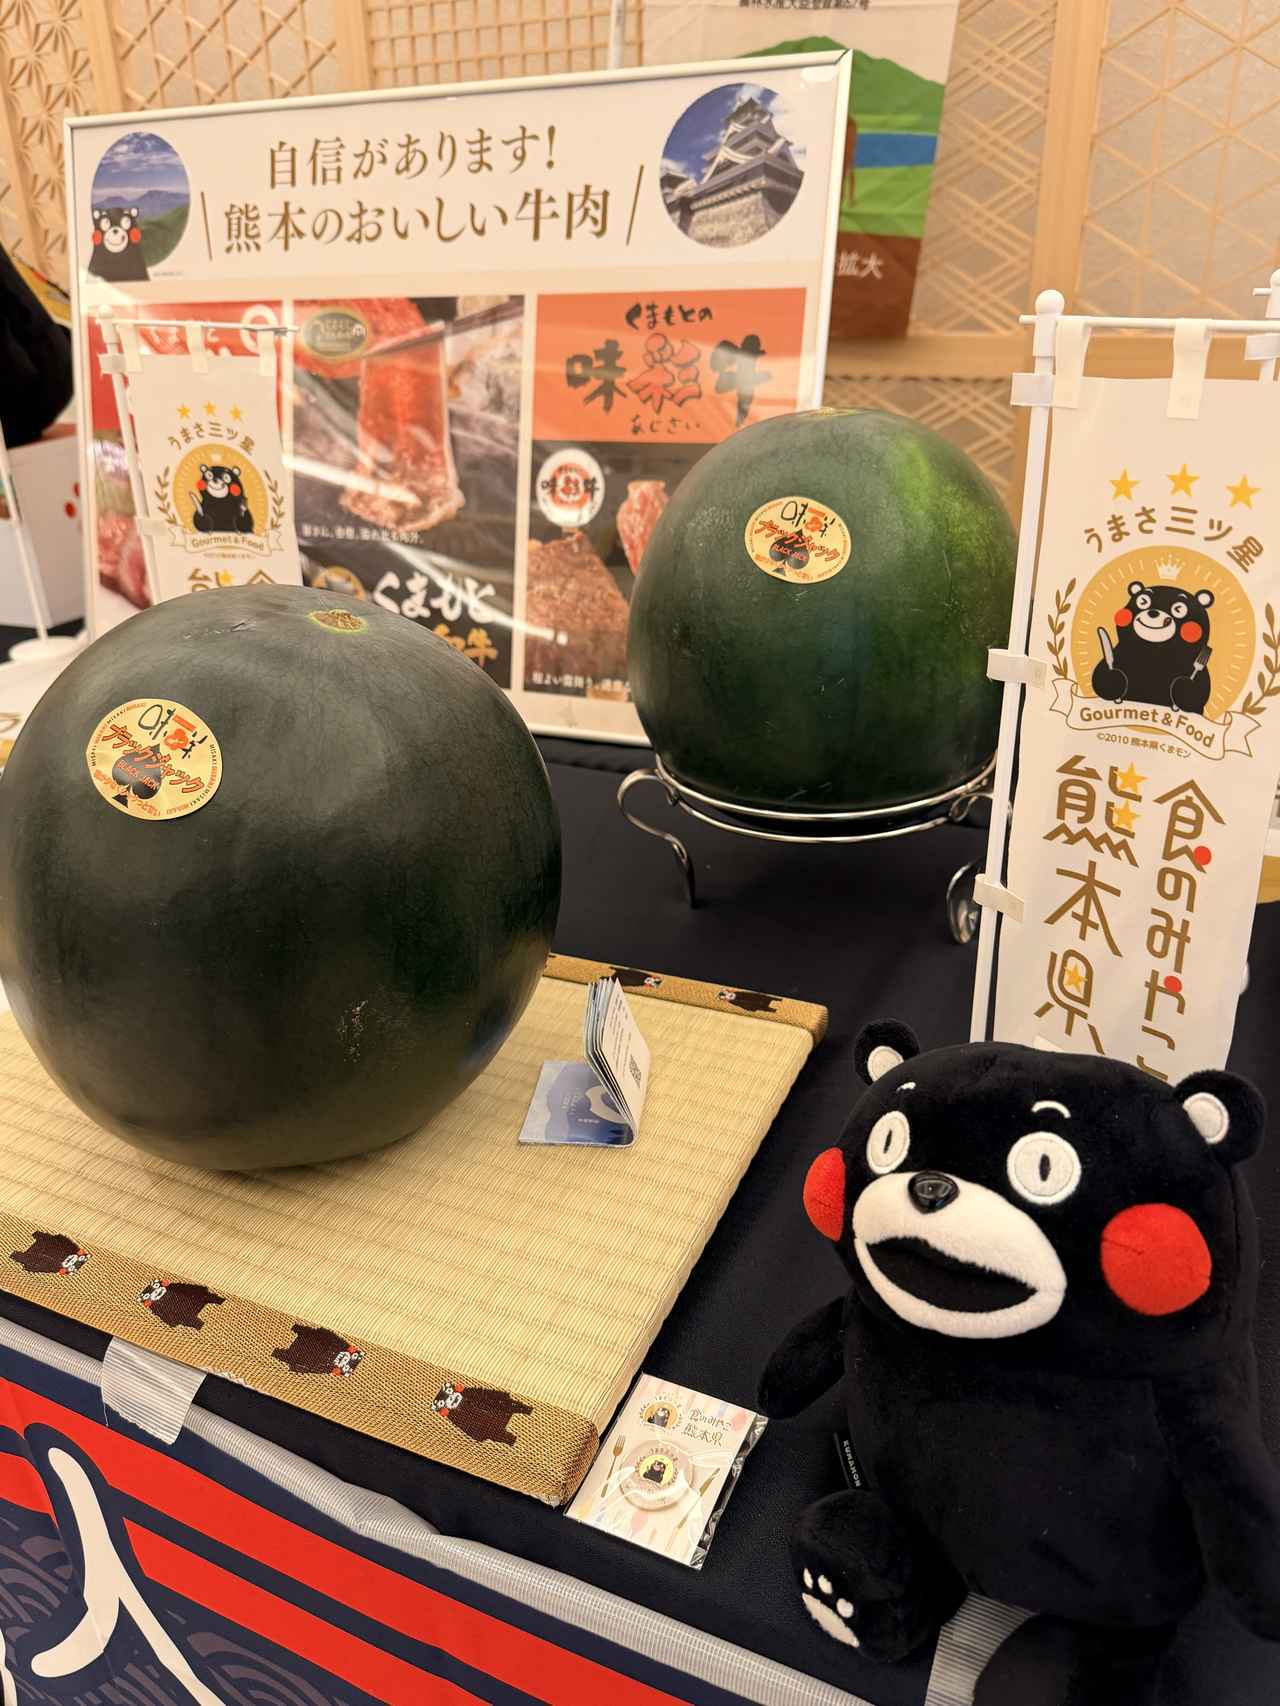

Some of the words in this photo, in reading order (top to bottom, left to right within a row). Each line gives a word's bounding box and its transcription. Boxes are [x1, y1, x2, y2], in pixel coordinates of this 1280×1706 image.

[224, 184, 610, 254] 熊本のおいしい牛肉
[625, 303, 713, 330] くまもとの
[167, 421, 256, 455] うまさ三ツ星
[1084, 505, 1264, 574] うまさ三ツ星
[1034, 754, 1149, 1055] 熊本県
